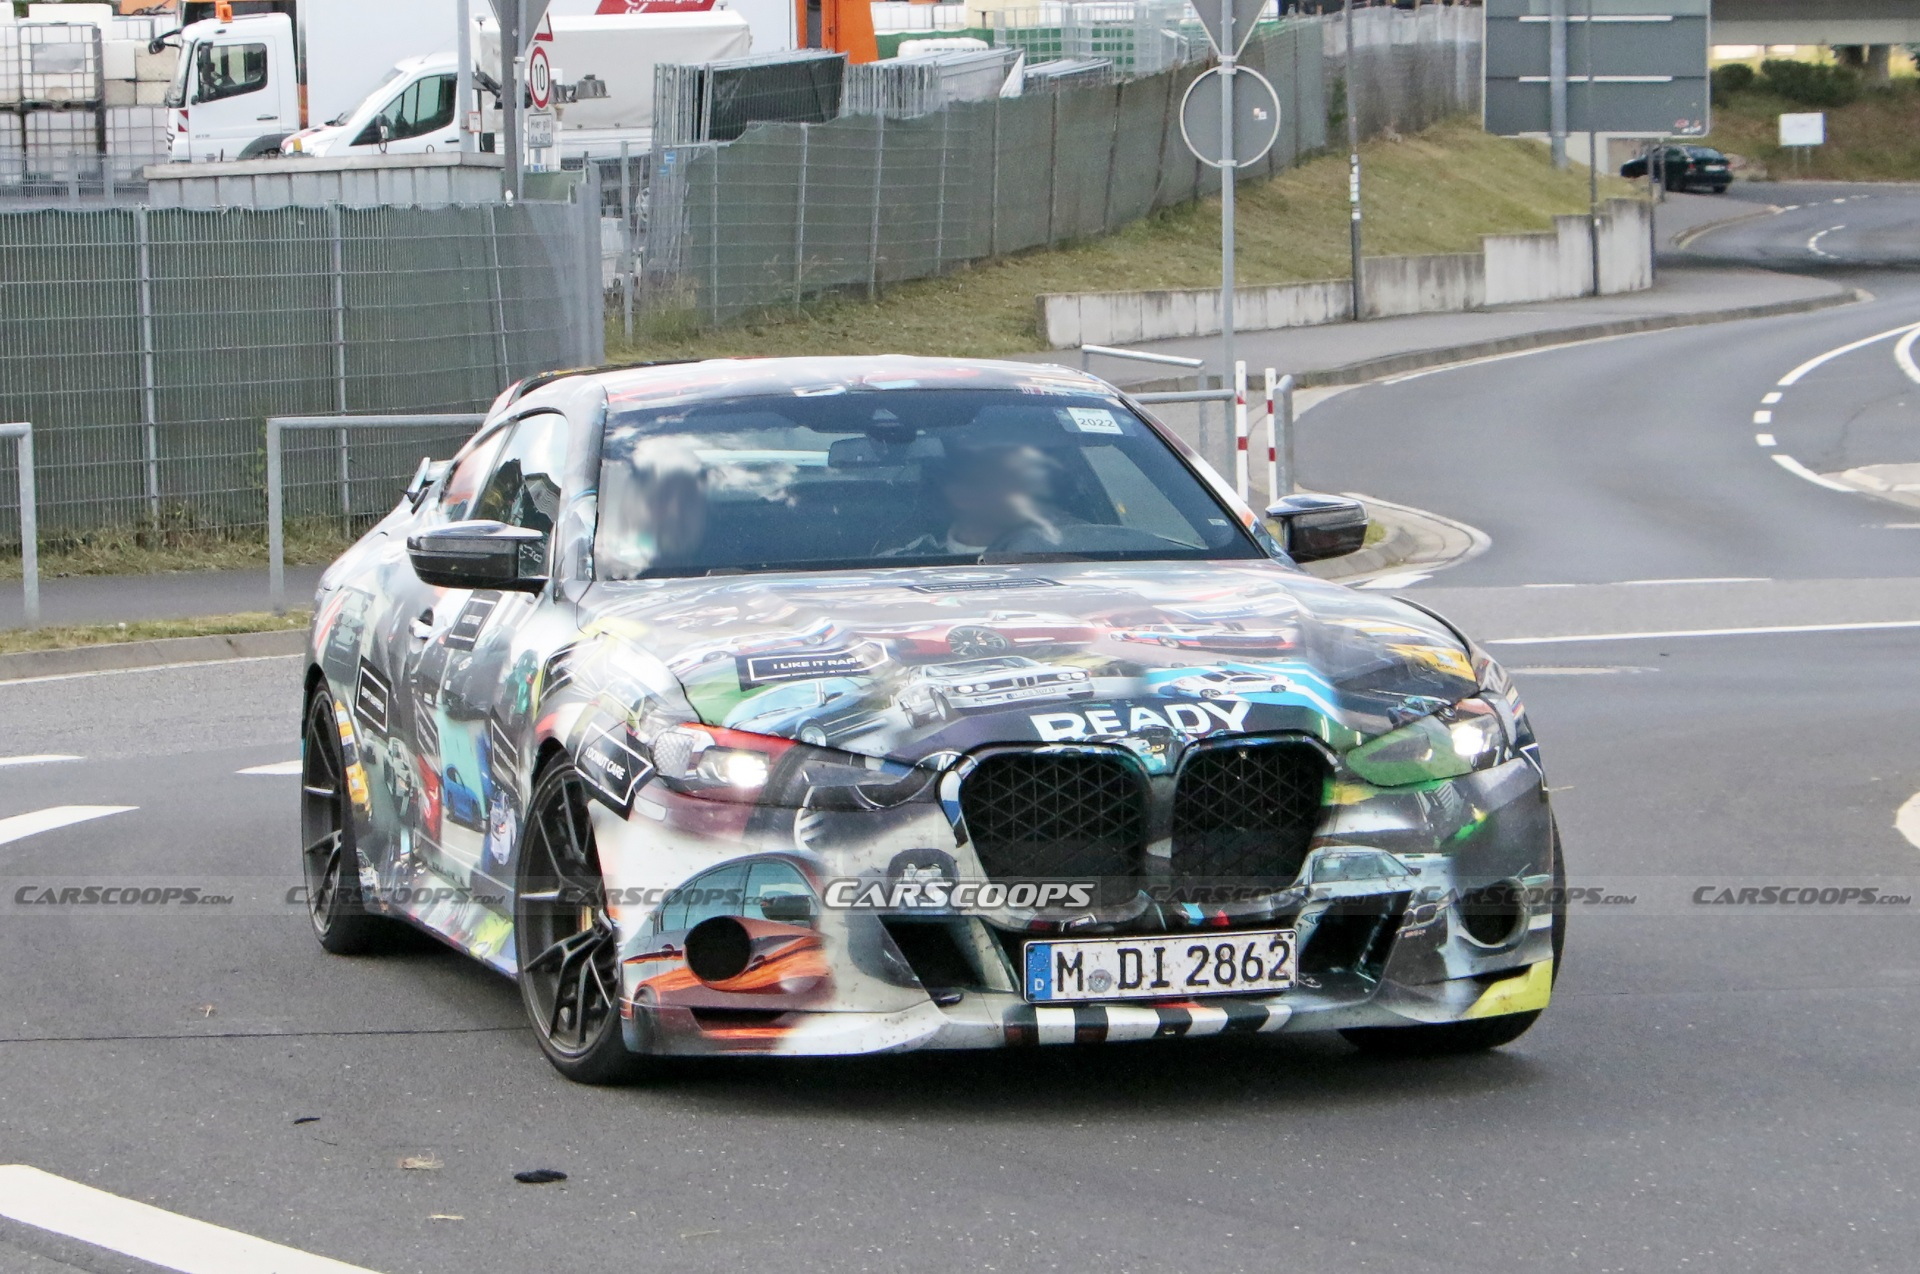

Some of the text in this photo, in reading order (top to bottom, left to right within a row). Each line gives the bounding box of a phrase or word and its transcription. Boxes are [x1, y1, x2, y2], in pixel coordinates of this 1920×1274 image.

[534, 63, 546, 92] 10
[1077, 416, 1116, 428] 2022
[779, 661, 810, 670] LIKE
[811, 660, 826, 668] IT
[1029, 700, 1253, 742] READY
[606, 760, 626, 781] CARE
[1056, 939, 1292, 993] M DI 2862
[1034, 977, 1045, 991] D
